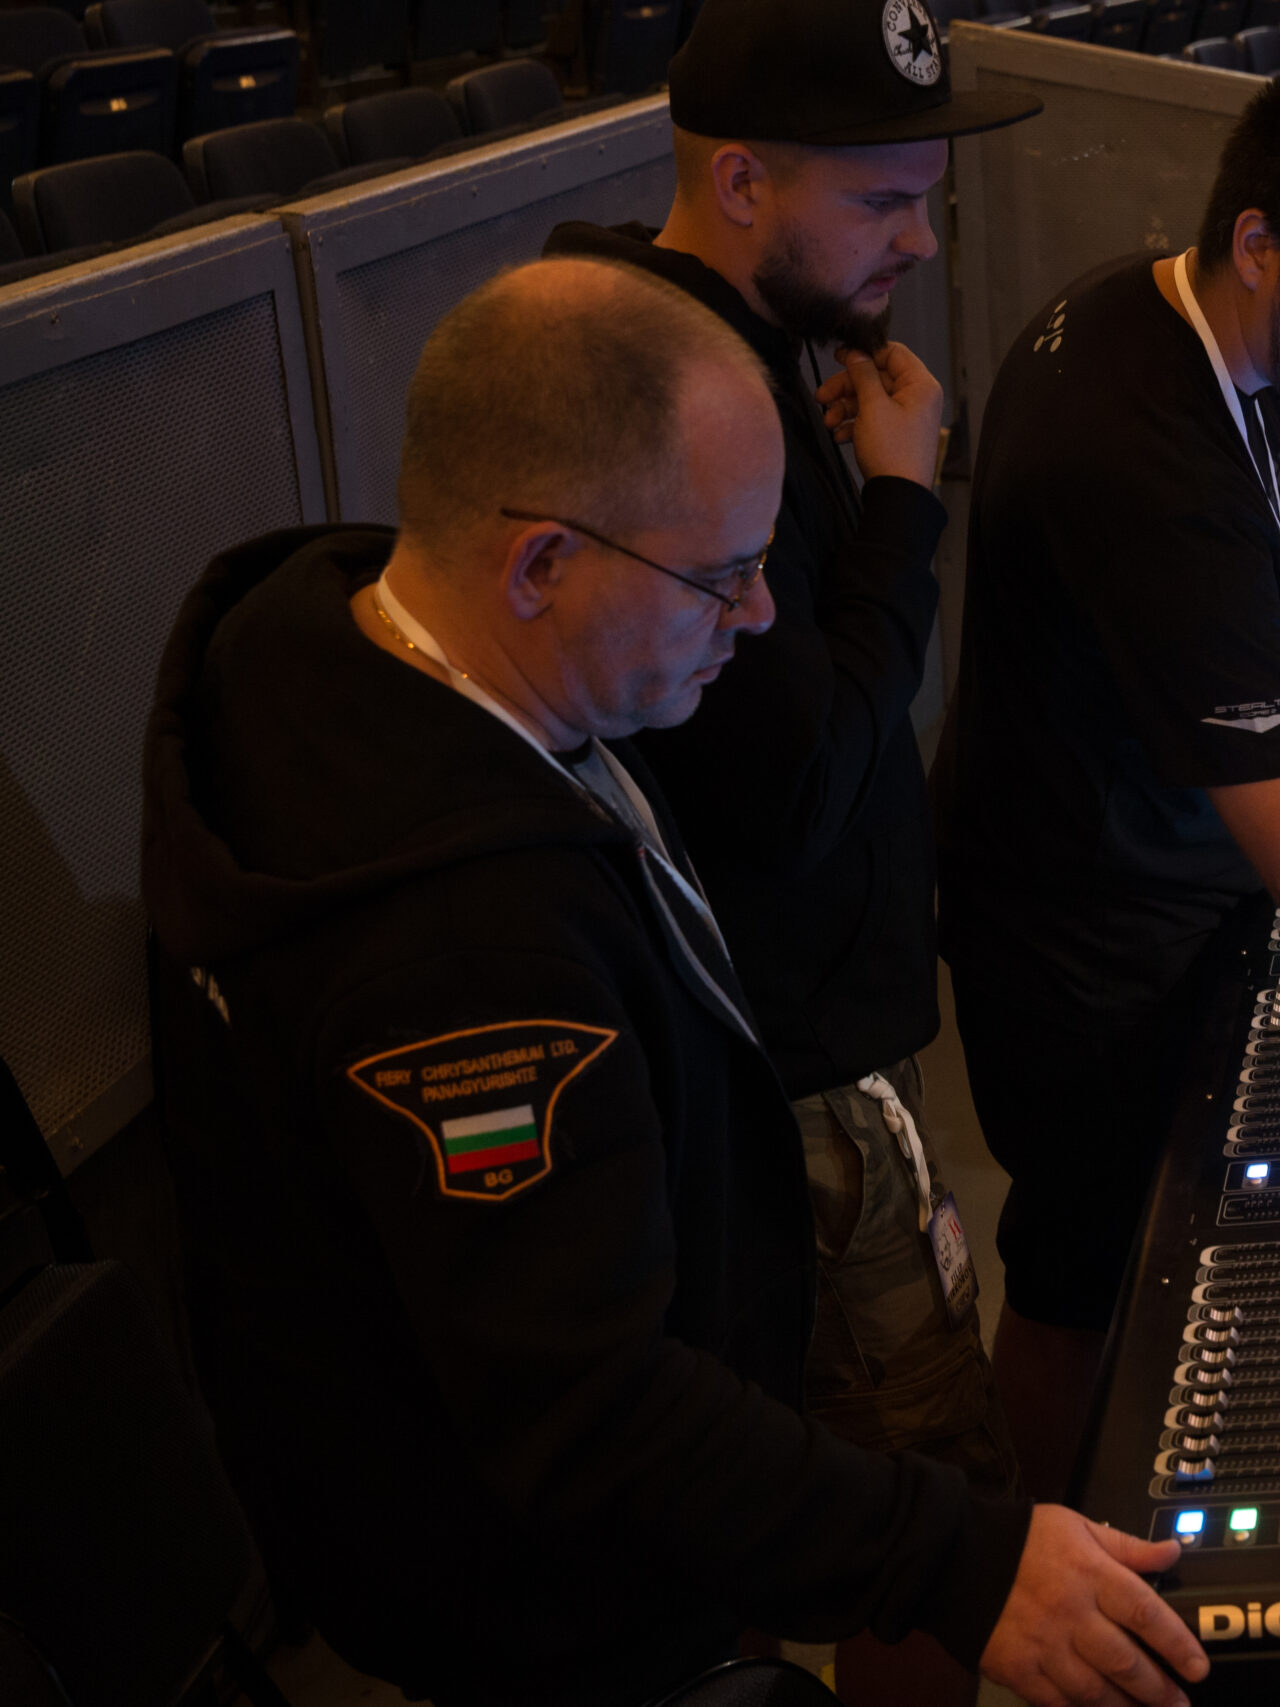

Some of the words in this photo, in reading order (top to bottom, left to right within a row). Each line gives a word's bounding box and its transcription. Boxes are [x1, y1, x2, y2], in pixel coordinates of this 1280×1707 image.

[904, 61, 924, 79] ALL
[375, 1069, 412, 1088] FIERY
[421, 1044, 546, 1083] CHRYSANTHEMUM
[550, 1039, 578, 1057] LTD.
[421, 1066, 538, 1103] PANAGYURISHTE
[484, 1168, 514, 1188] BG
